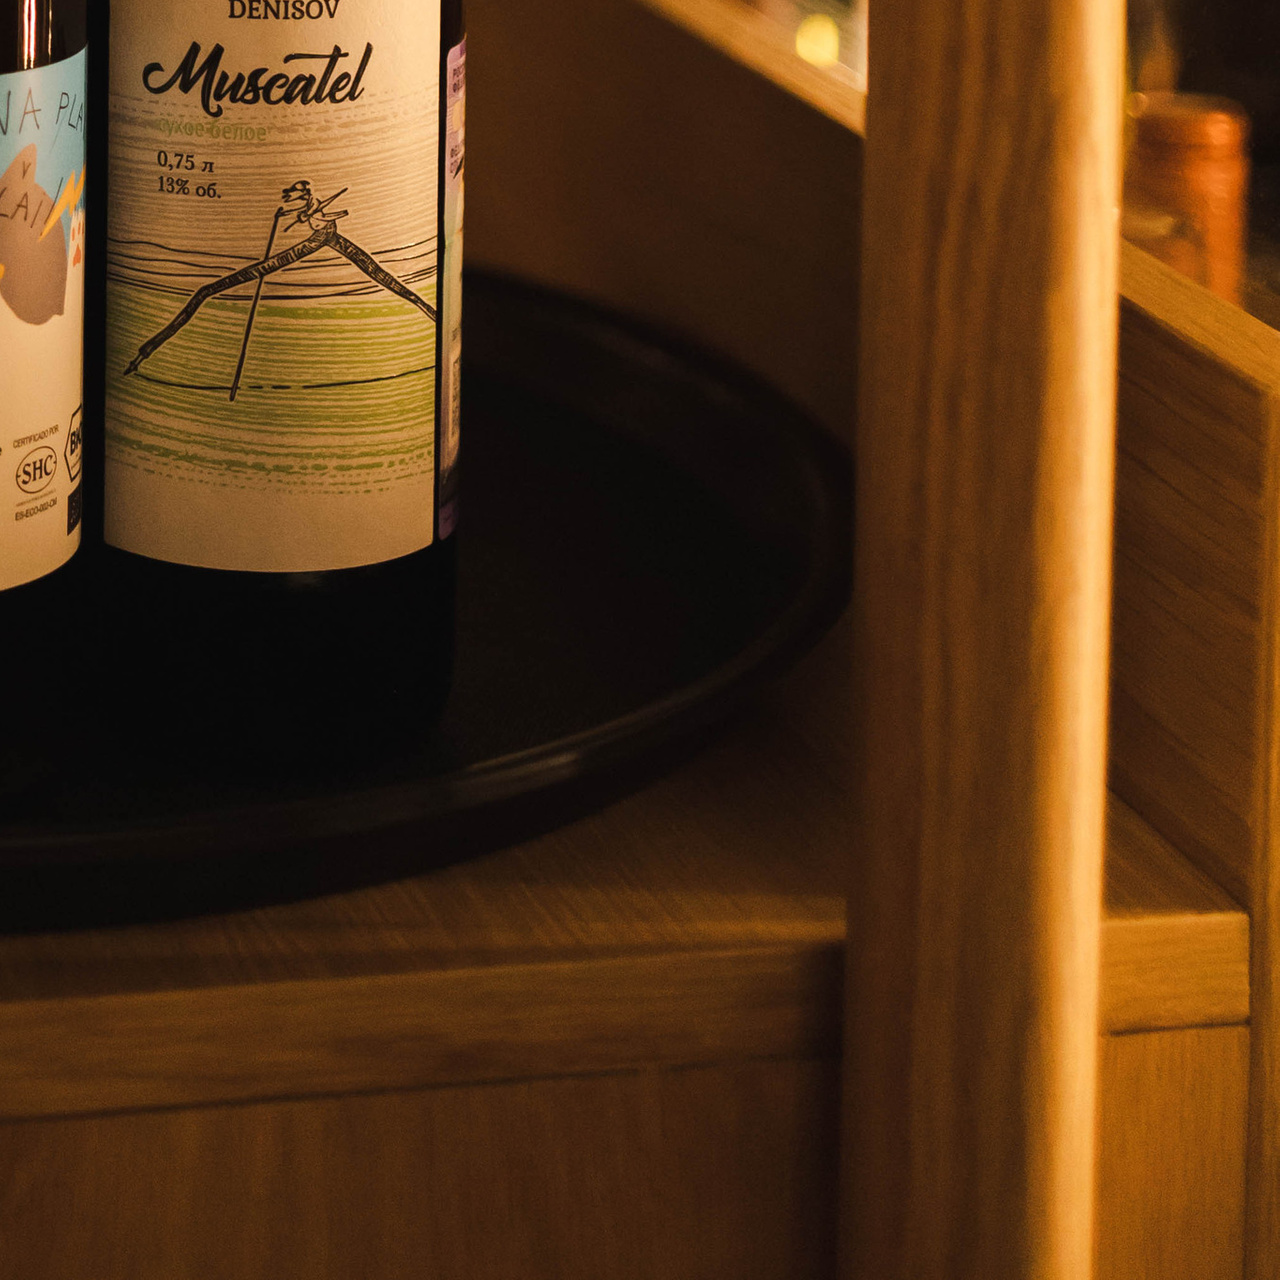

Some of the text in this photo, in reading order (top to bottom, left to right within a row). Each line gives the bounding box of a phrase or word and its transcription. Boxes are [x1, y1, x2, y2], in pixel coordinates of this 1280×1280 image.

[141, 41, 373, 117] Muscatel
[158, 120, 267, 142] сухое белое
[157, 150, 215, 173] 0,75 л
[158, 175, 222, 199] 13% об.
